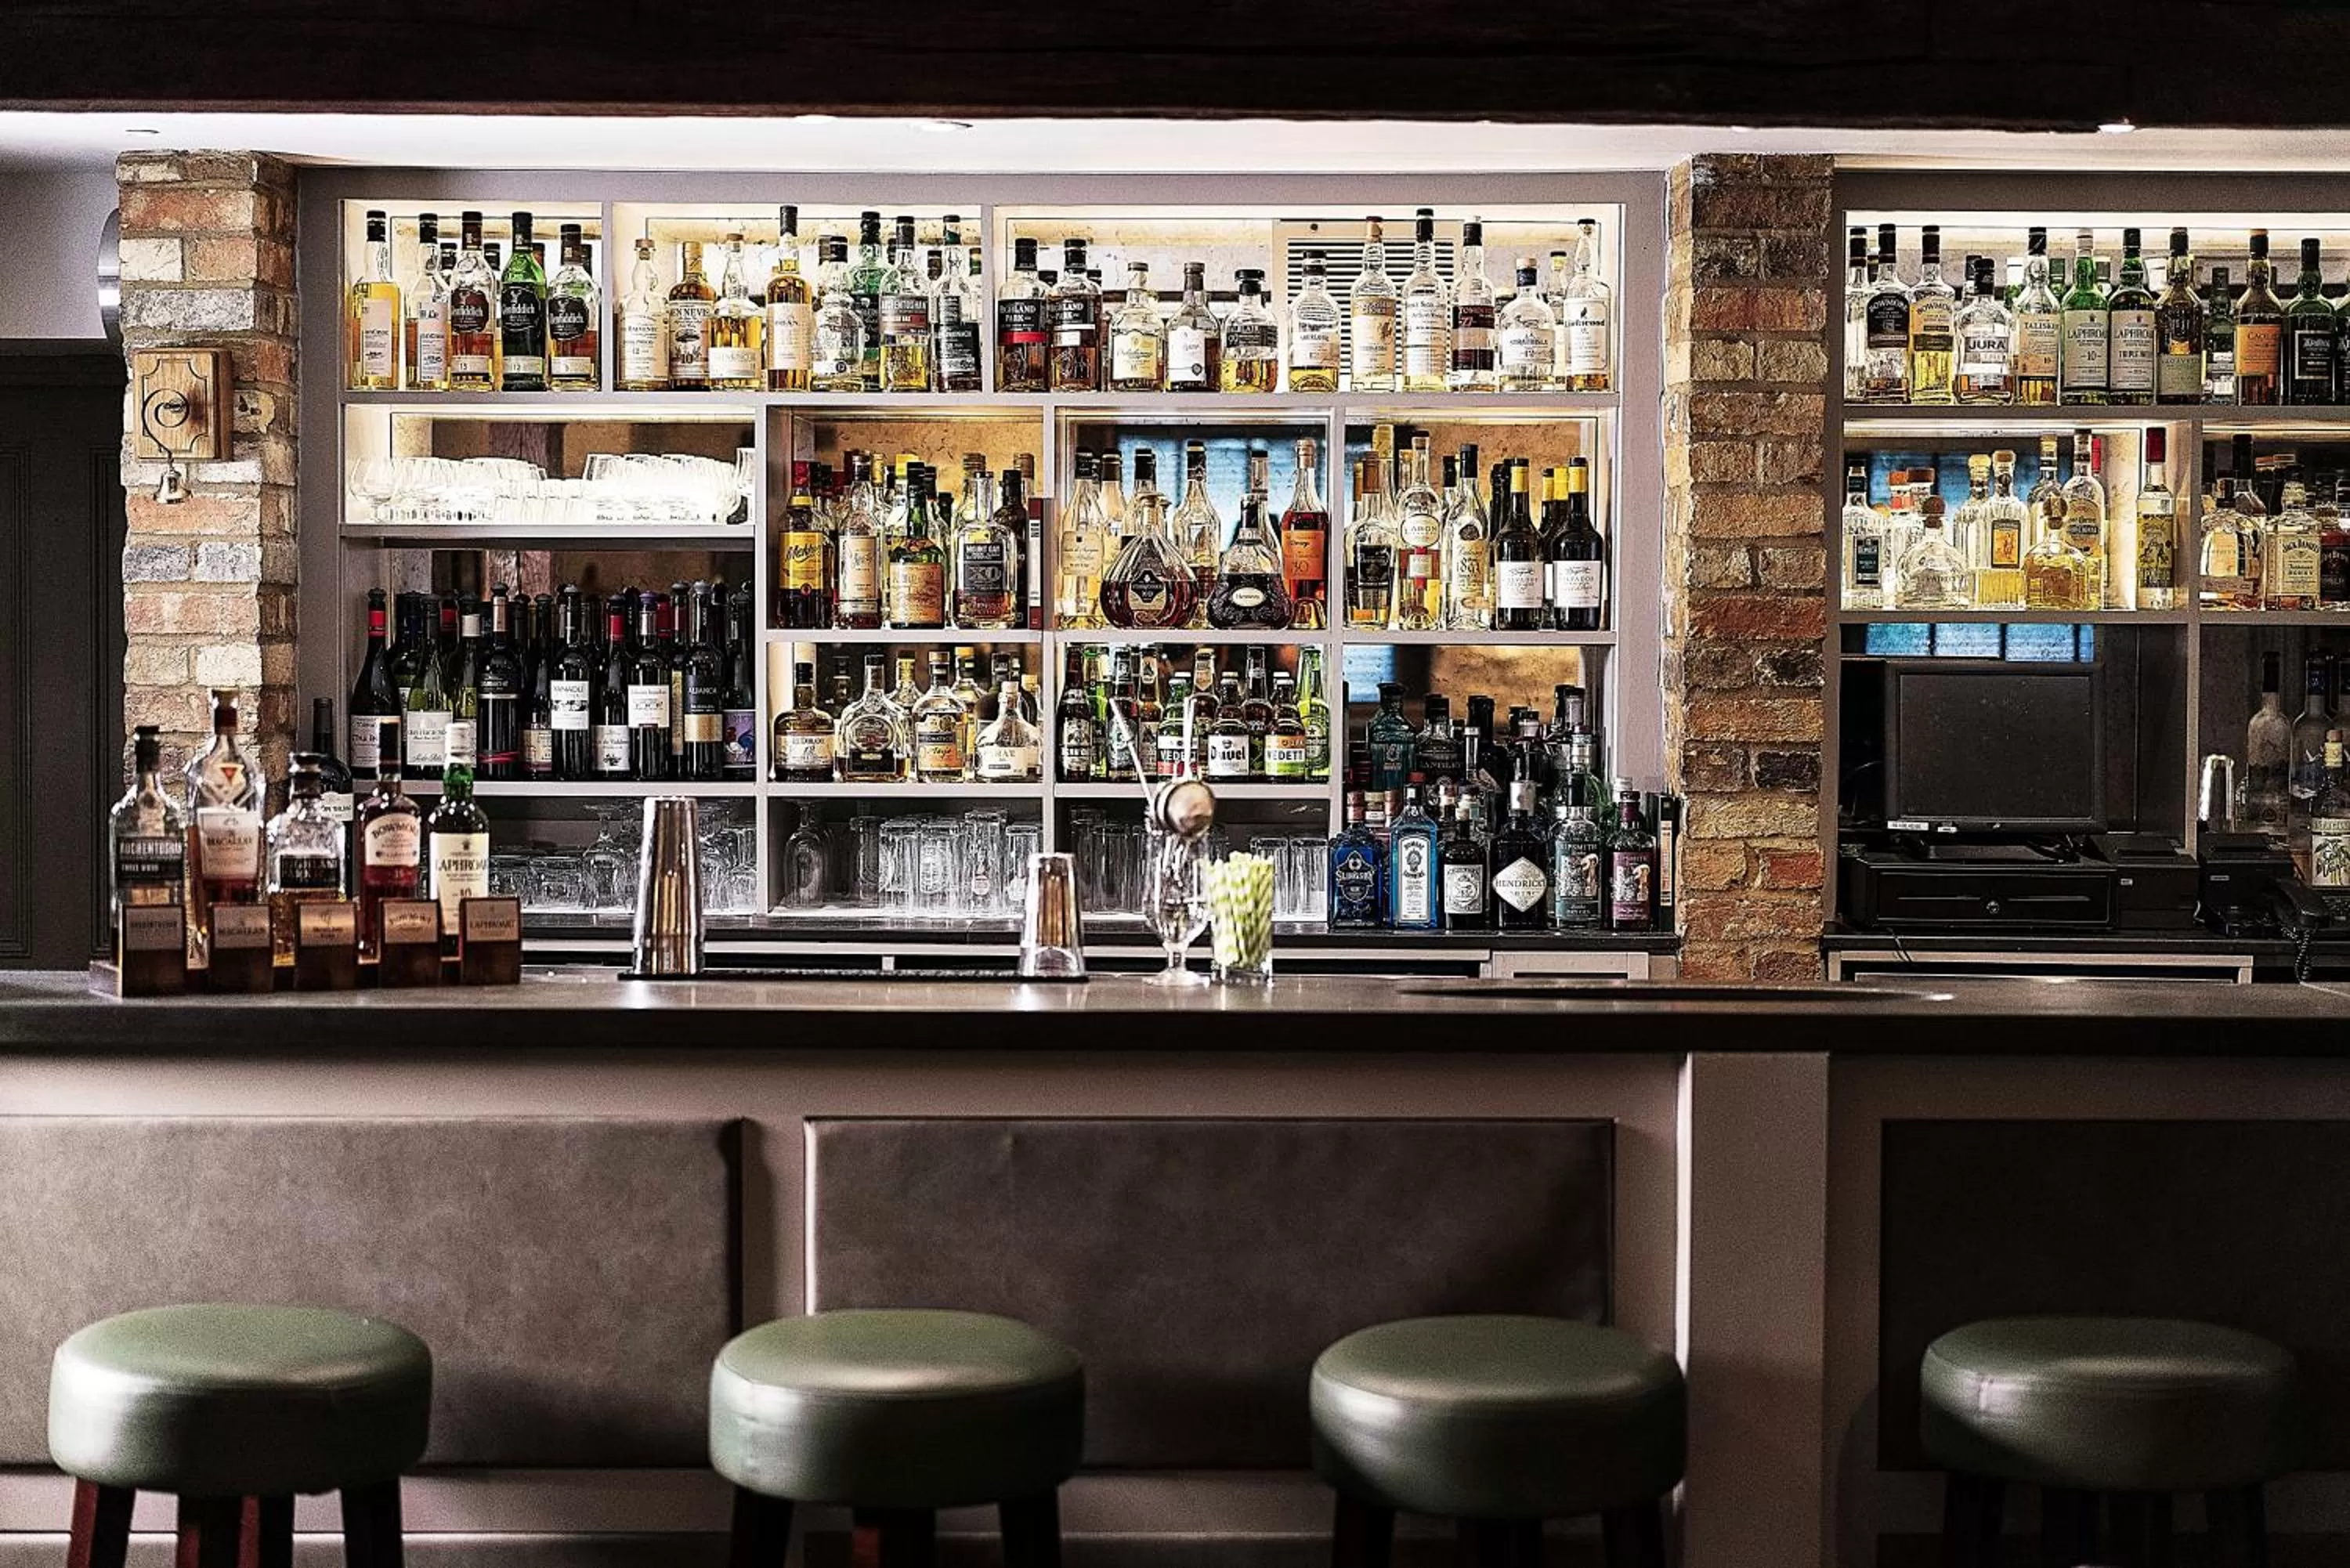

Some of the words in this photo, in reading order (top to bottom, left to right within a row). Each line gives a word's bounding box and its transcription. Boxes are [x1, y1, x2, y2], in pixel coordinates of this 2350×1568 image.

[1968, 339, 2006, 350] JURA
[681, 353, 693, 364] 10
[2086, 350, 2097, 361] 10
